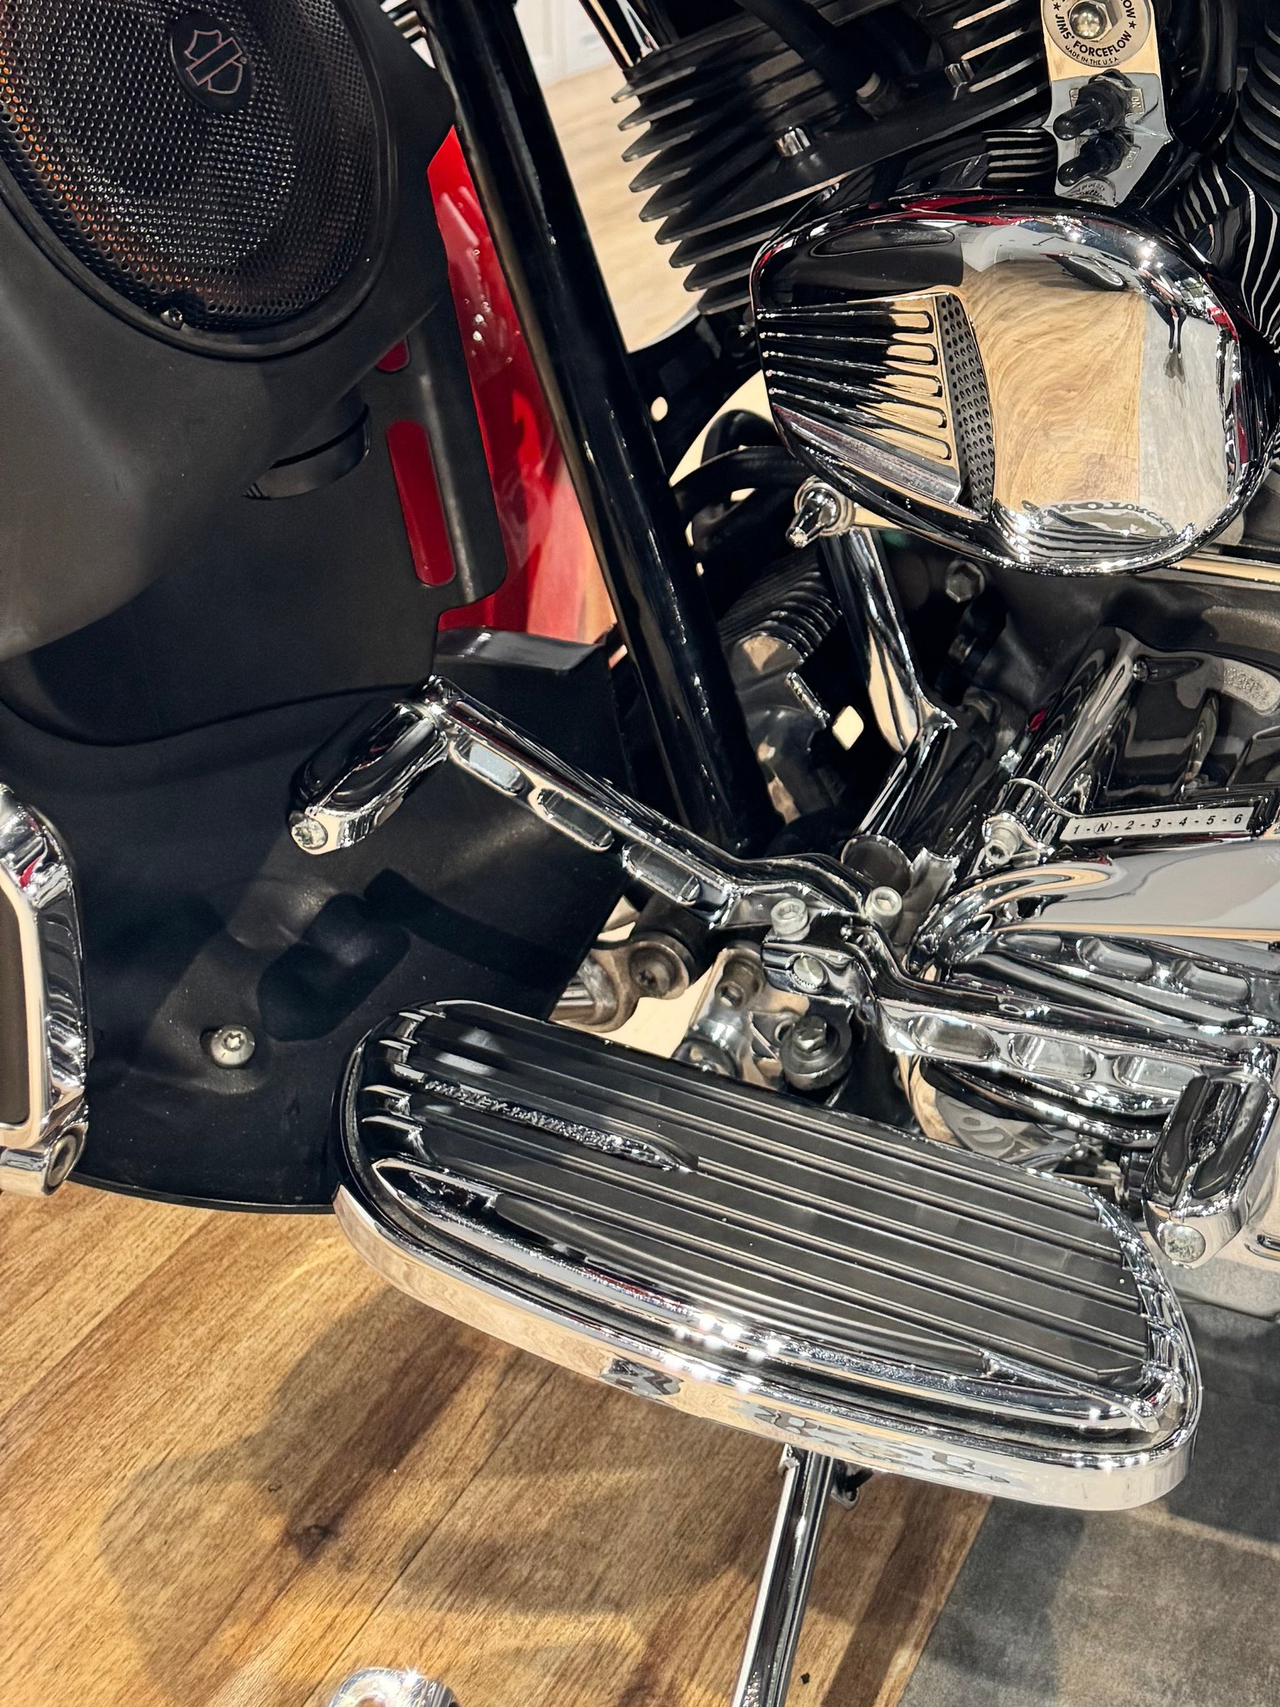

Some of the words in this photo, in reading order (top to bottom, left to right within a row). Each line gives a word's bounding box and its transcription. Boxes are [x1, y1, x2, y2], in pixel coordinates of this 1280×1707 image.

[1073, 30, 1132, 57] FORCEFLOW
[1089, 58, 1101, 66] THE
[1073, 824, 1081, 835] 1
[1124, 820, 1134, 831] 2
[1152, 818, 1161, 828] 3
[1178, 817, 1188, 827] 4
[1206, 815, 1216, 825] 5
[1233, 813, 1243, 824] 6
